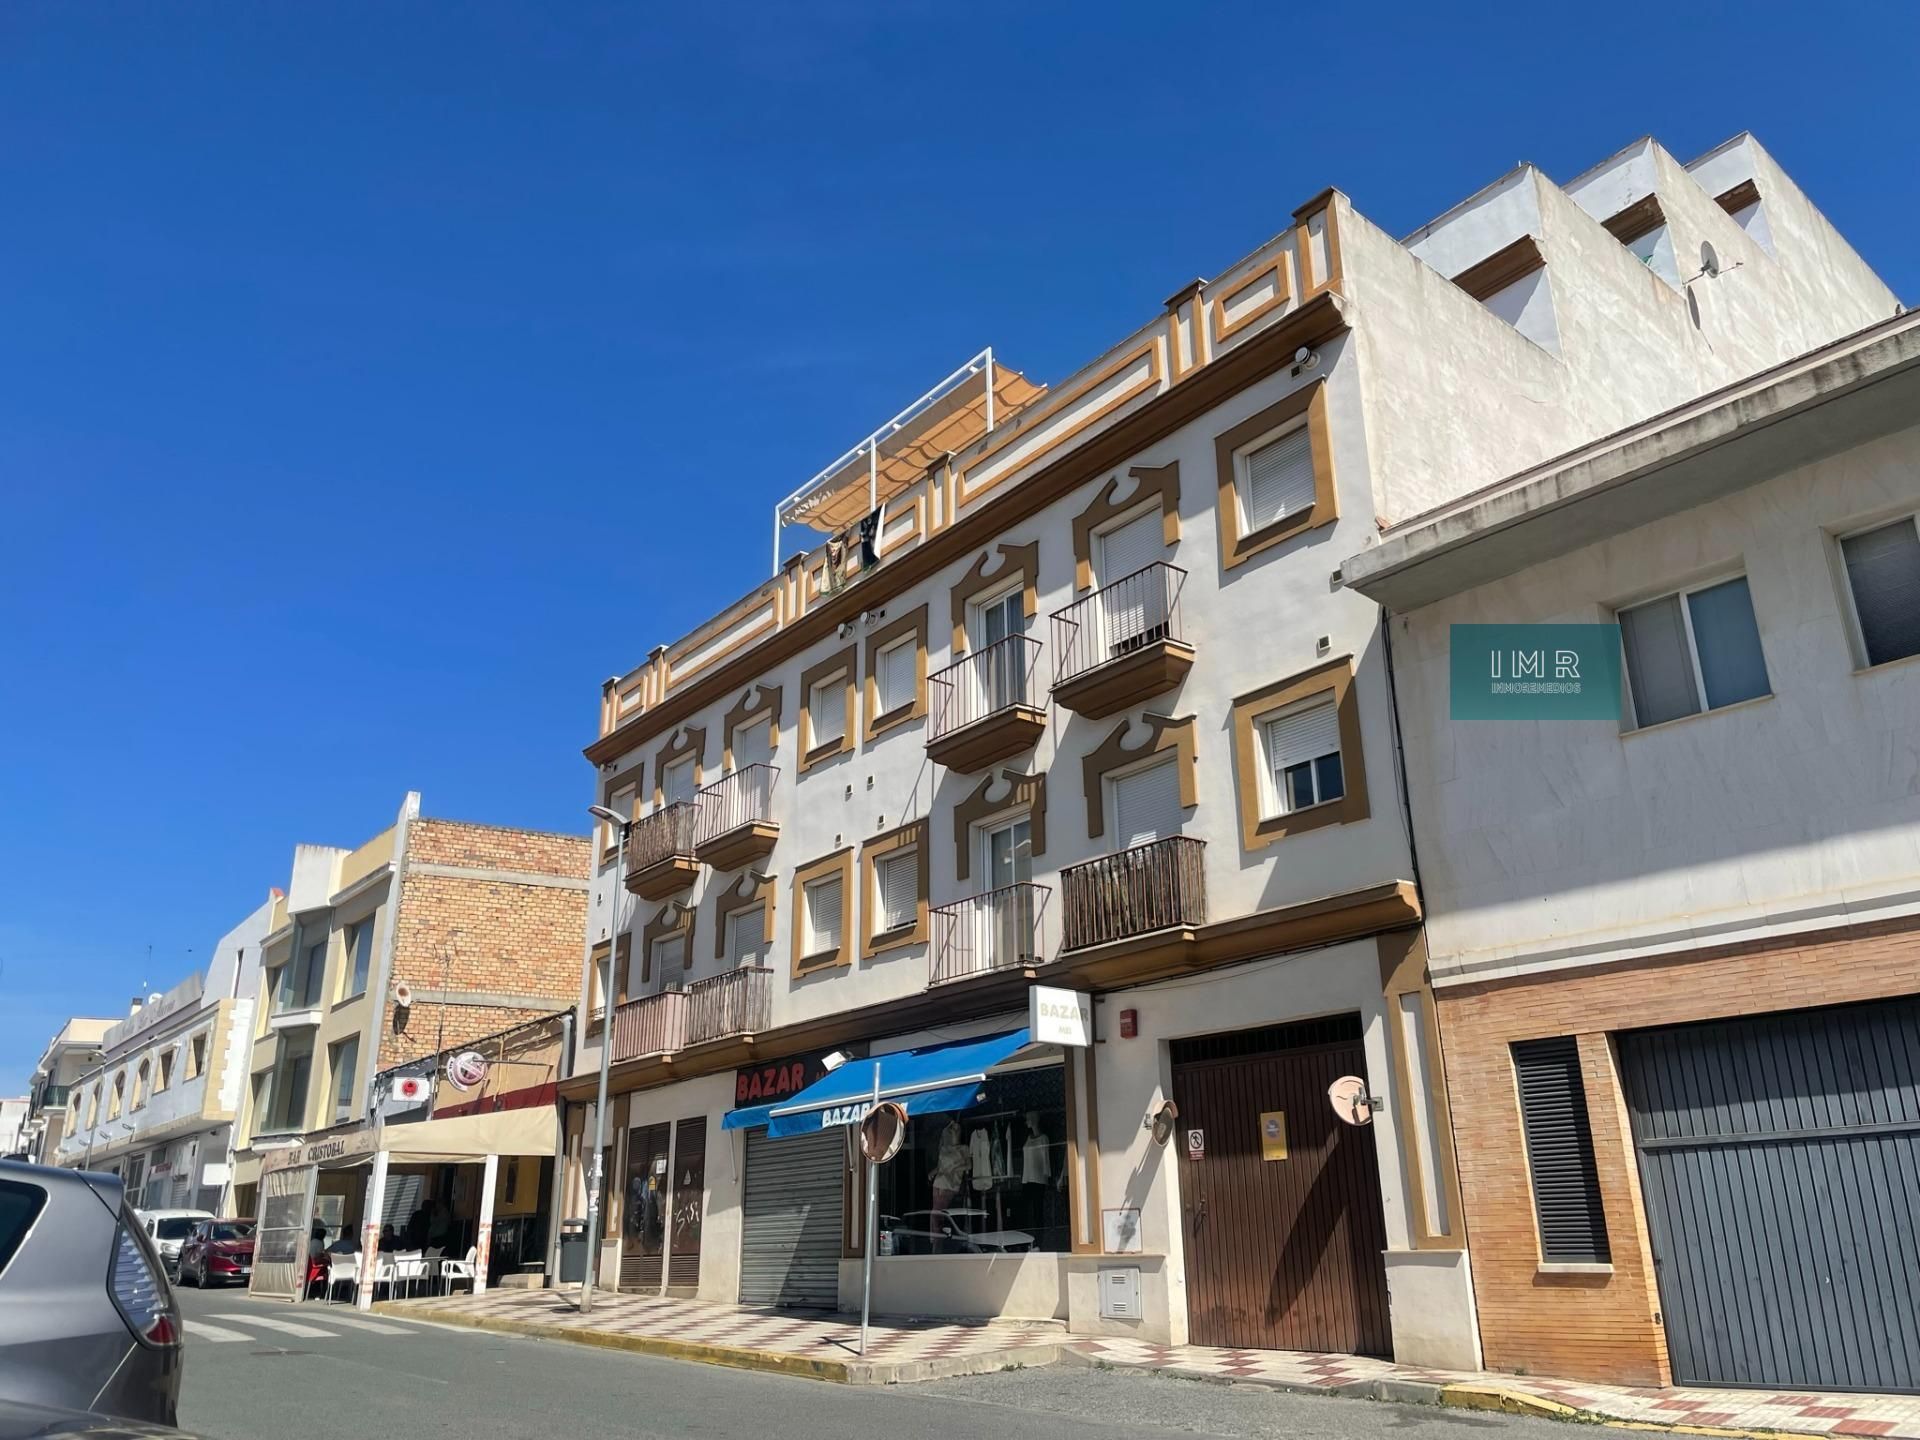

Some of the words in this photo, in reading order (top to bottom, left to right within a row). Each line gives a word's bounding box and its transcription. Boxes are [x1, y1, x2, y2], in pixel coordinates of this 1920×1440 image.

[1040, 1003, 1089, 1021] BAZAR
[736, 1063, 804, 1101] BAZAR
[822, 1103, 871, 1128] BAZAR
[308, 1140, 345, 1161] CRISTOBAL
